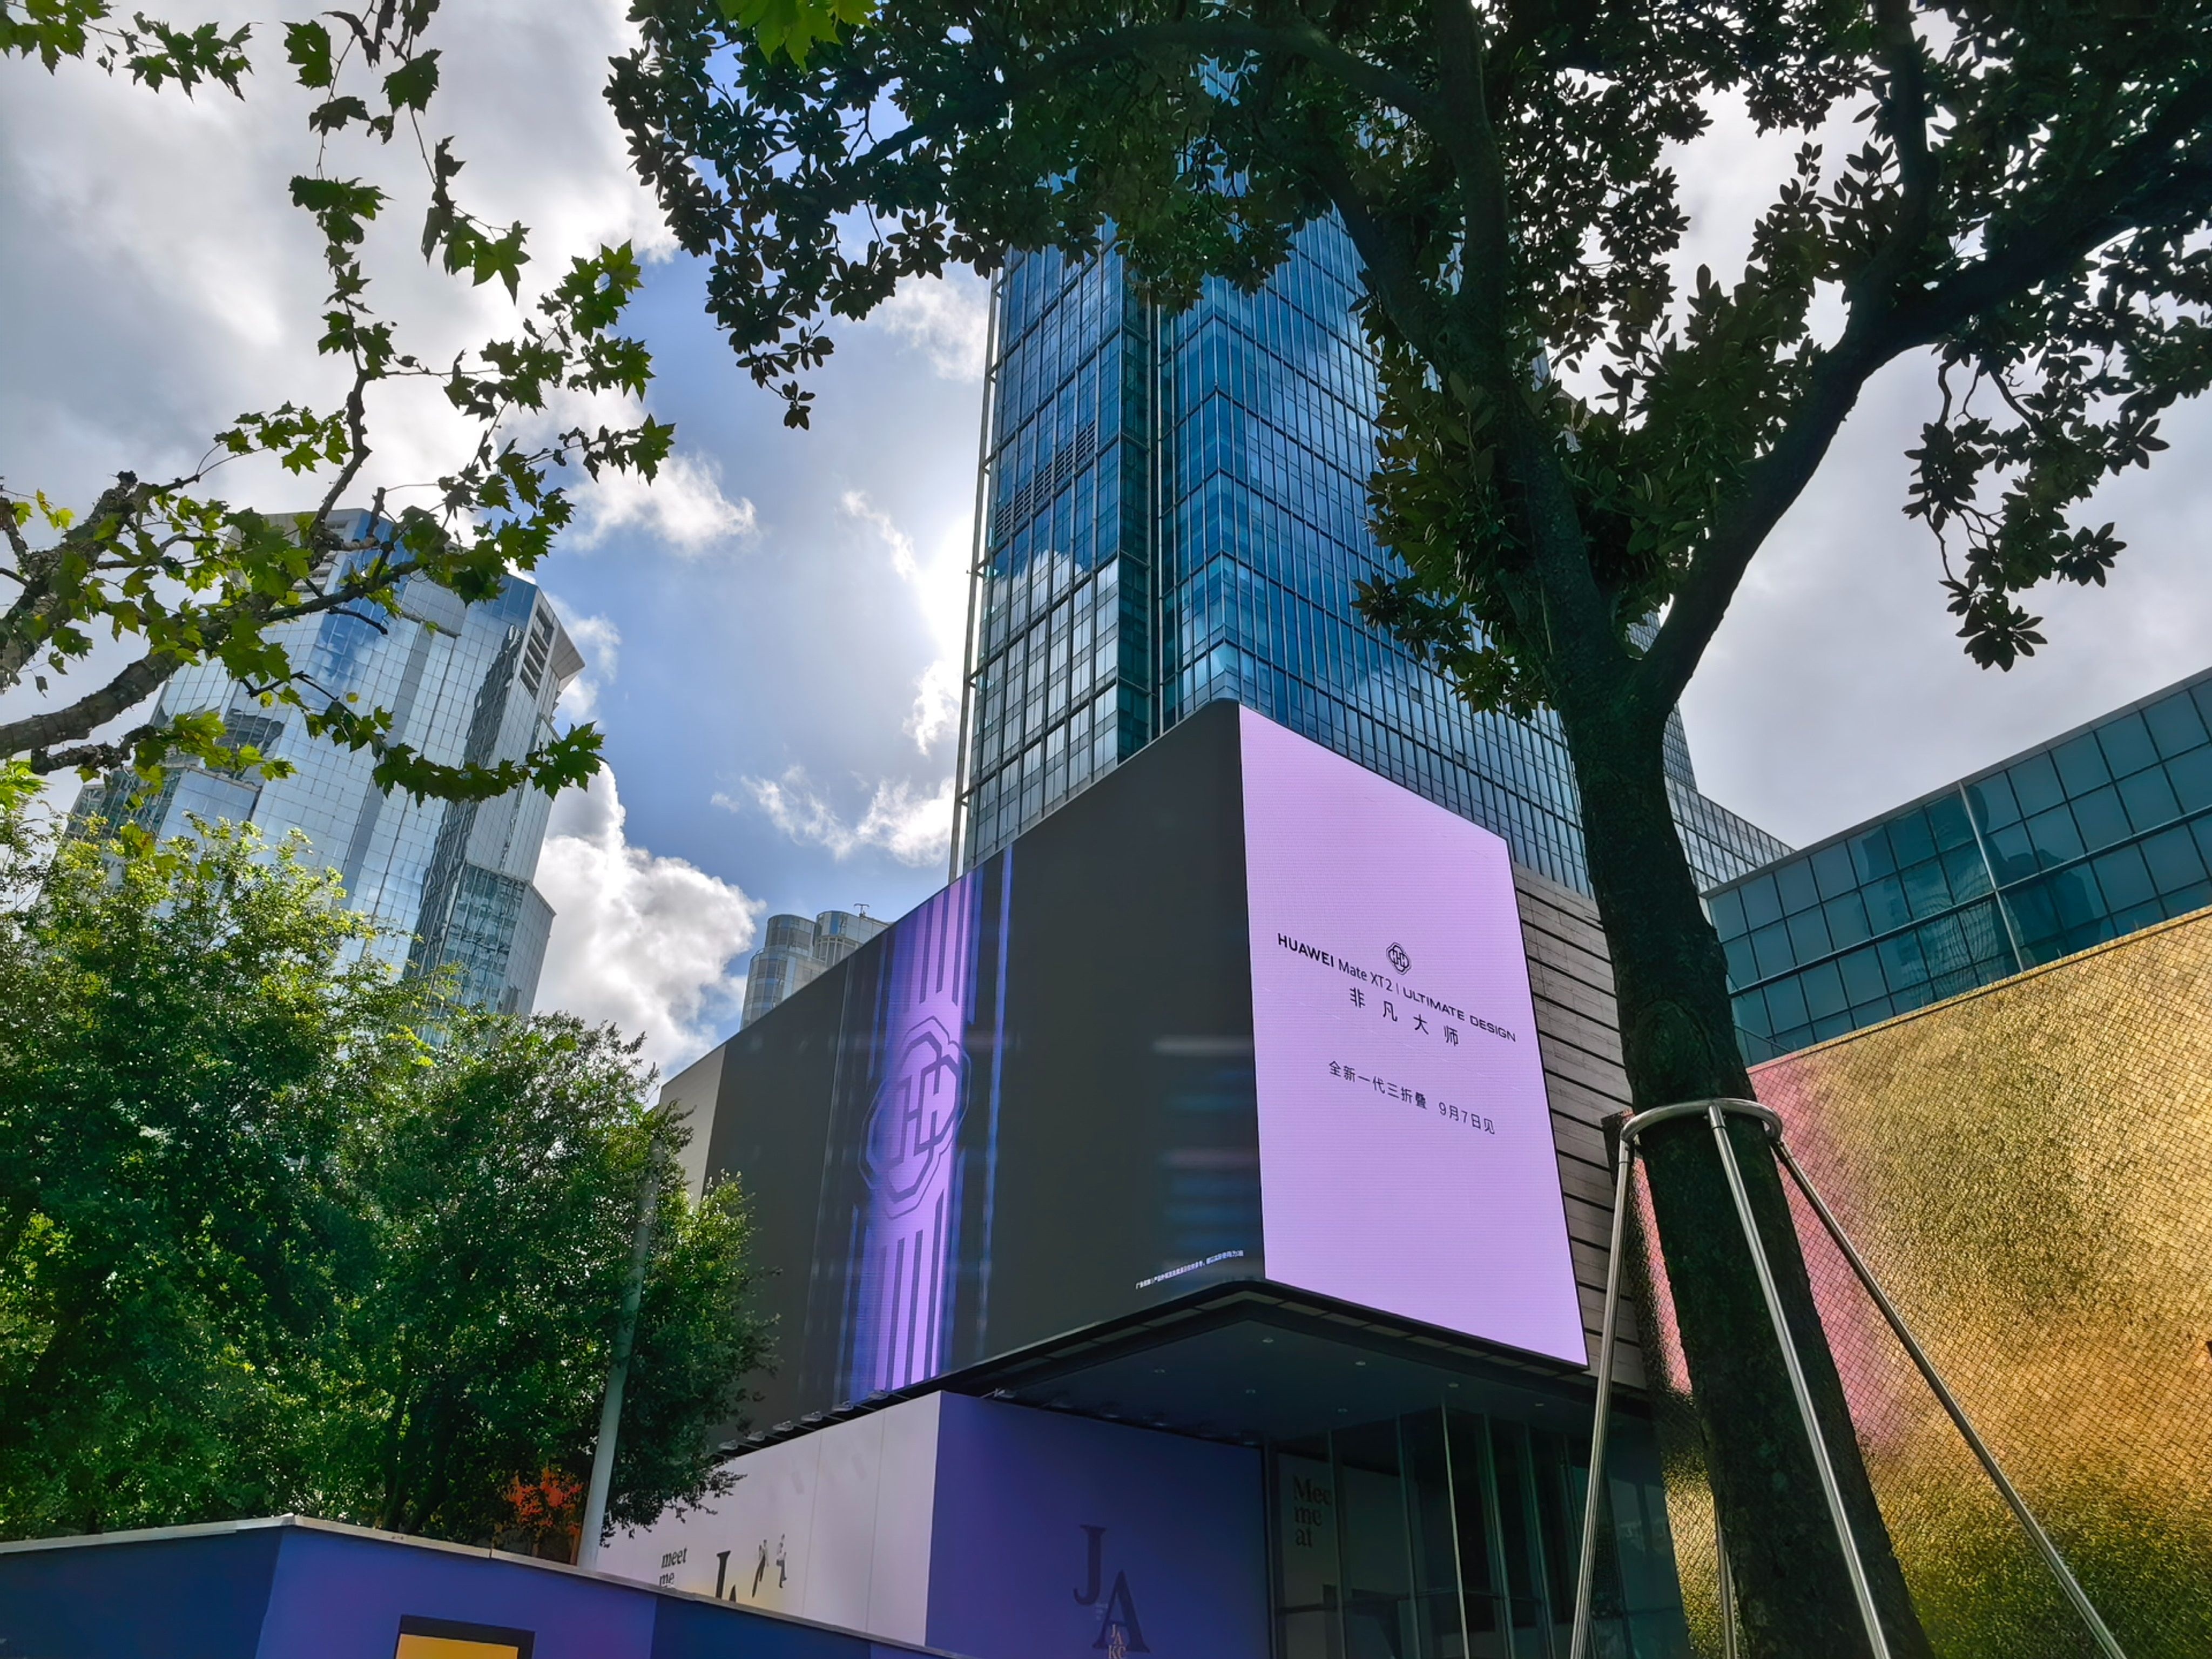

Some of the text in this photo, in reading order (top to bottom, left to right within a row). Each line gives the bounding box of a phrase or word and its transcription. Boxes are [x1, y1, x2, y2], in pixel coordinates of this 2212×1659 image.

[1277, 932, 1334, 968] HUAWEI
[1338, 958, 1367, 982] Mate
[1370, 971, 1393, 992] XT2
[1403, 987, 1465, 1021] ULTIMATE
[1469, 1015, 1516, 1042] DESIGN
[1350, 987, 1459, 1047] 非凡大师
[1328, 1060, 1495, 1135] 全新一代三折叠 9月7日见
[660, 1546, 687, 1569] meet
